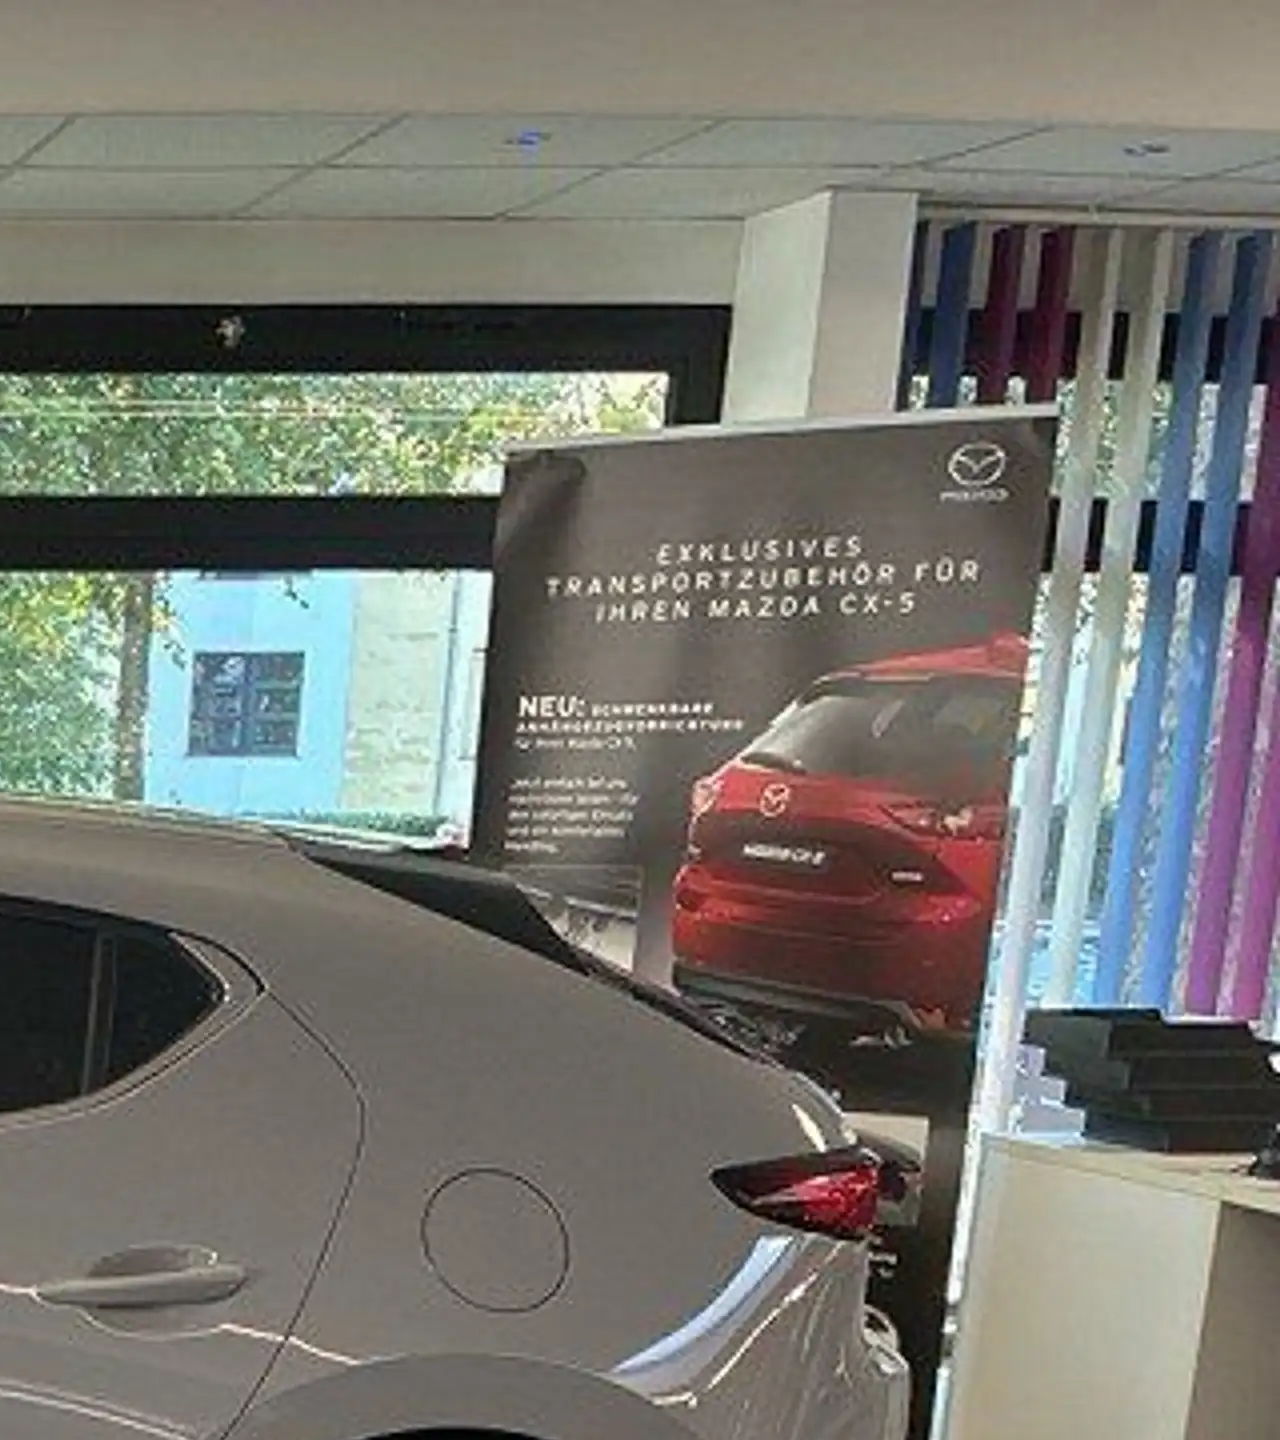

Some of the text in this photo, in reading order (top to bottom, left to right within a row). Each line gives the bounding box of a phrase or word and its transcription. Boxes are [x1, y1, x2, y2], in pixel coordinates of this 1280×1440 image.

[655, 534, 862, 566] EXKLUSIVES
[544, 556, 979, 598] TRANSPORTZUBEHÖR FÜR
[595, 591, 916, 624] IHREN MAZDA CX-5
[518, 696, 586, 718] NEU:
